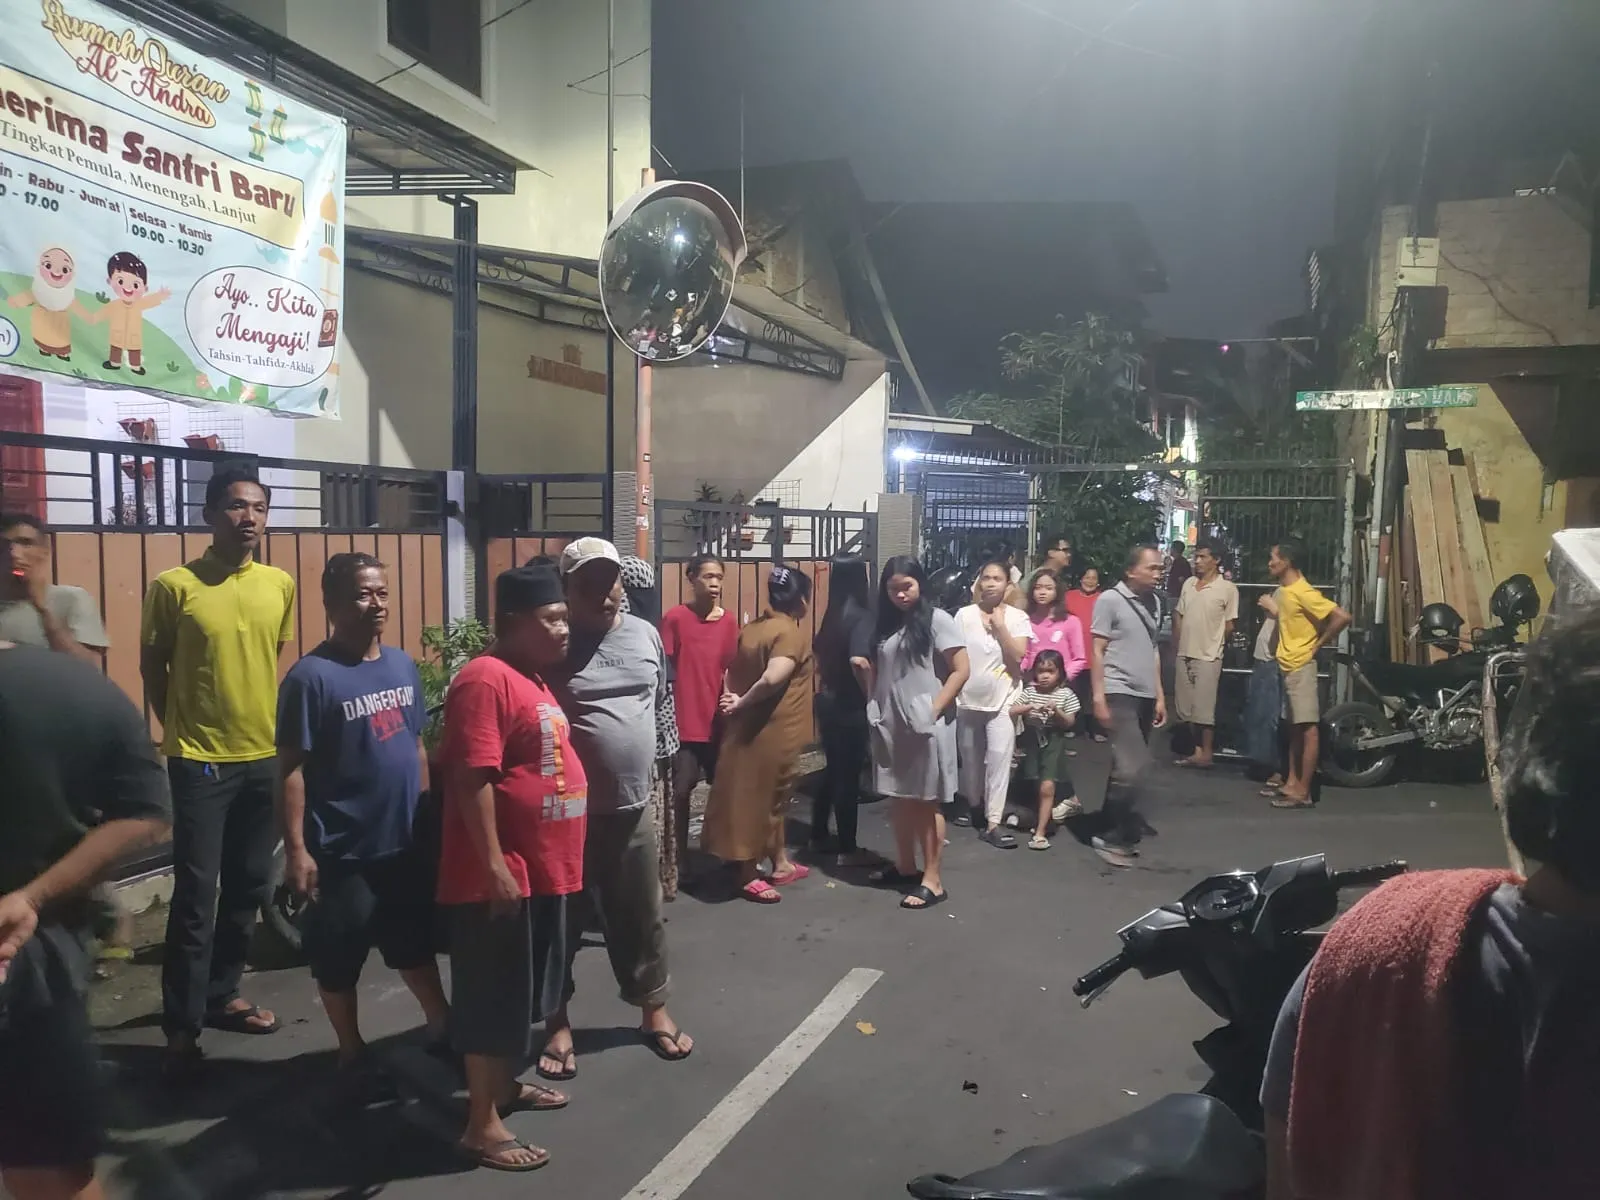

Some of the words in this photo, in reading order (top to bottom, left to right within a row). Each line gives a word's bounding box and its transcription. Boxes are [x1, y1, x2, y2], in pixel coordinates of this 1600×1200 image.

[41, 0, 142, 63] Rumah
[131, 66, 212, 125] Andra
[1, 120, 64, 158] Tingkat
[65, 146, 127, 183] Pemula,
[214, 200, 257, 224] Lanjut
[28, 171, 65, 195] Rabu
[121, 131, 222, 194] Santri
[230, 170, 296, 218] Baru
[24, 191, 59, 212] 17.00
[129, 207, 167, 229] Selasa
[178, 222, 213, 242] Kamis
[131, 224, 165, 244] 09.00
[177, 239, 204, 256] 10.30
[266, 287, 317, 318] Kita
[215, 312, 311, 356] Mengaji!
